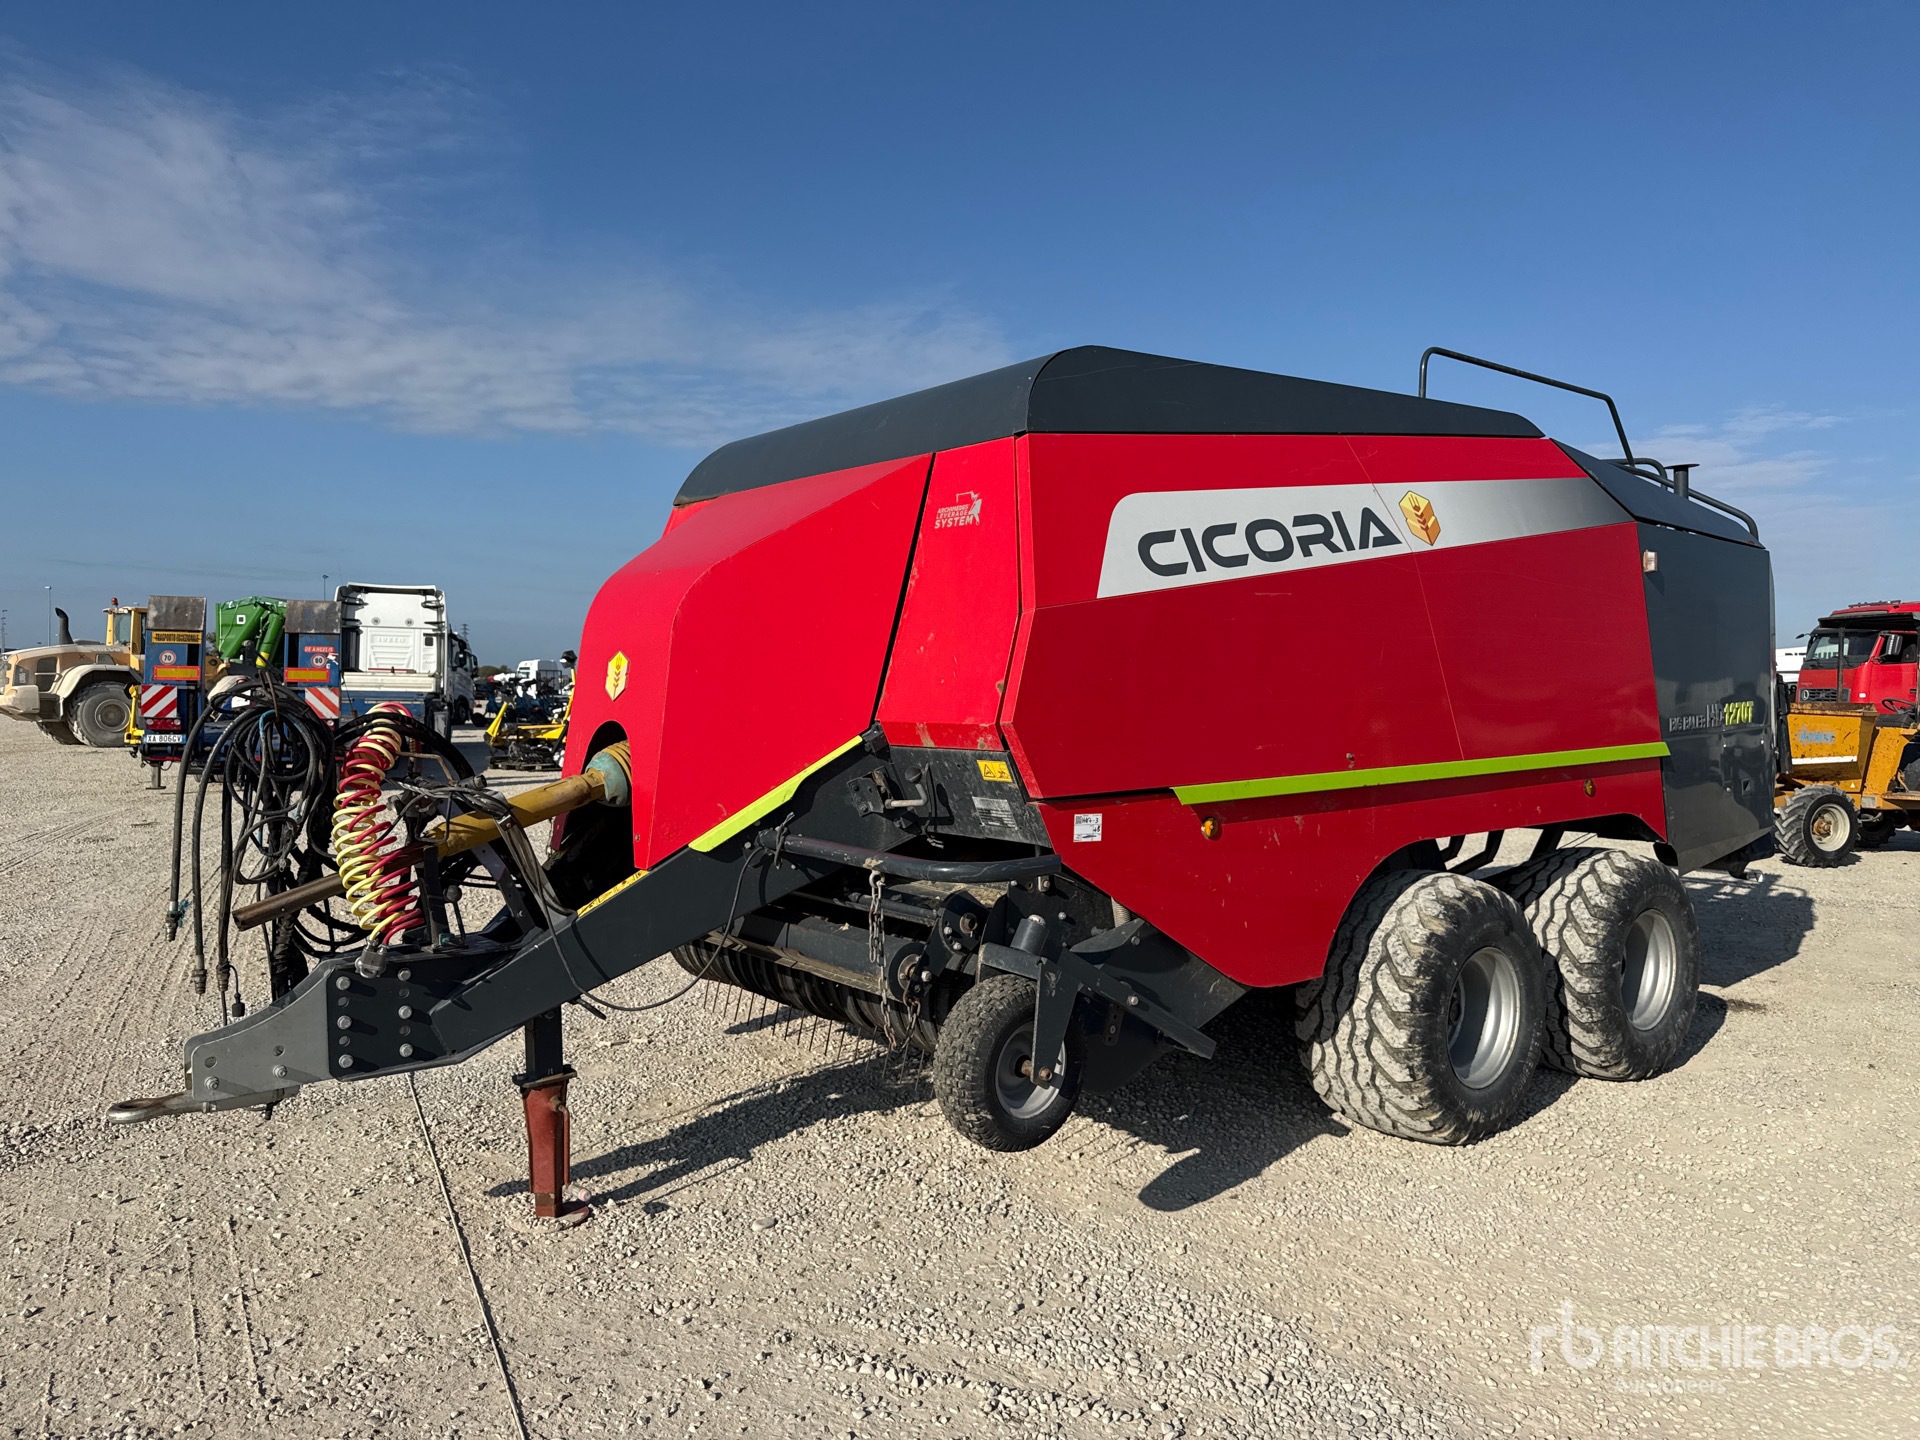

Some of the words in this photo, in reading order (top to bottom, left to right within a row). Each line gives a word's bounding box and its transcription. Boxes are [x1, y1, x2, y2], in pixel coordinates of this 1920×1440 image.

[934, 515, 974, 529] SYSTEM
[936, 510, 968, 520] LEVERAGE
[1138, 507, 1402, 577] CICORIA
[1723, 700, 1755, 726] 1270T
